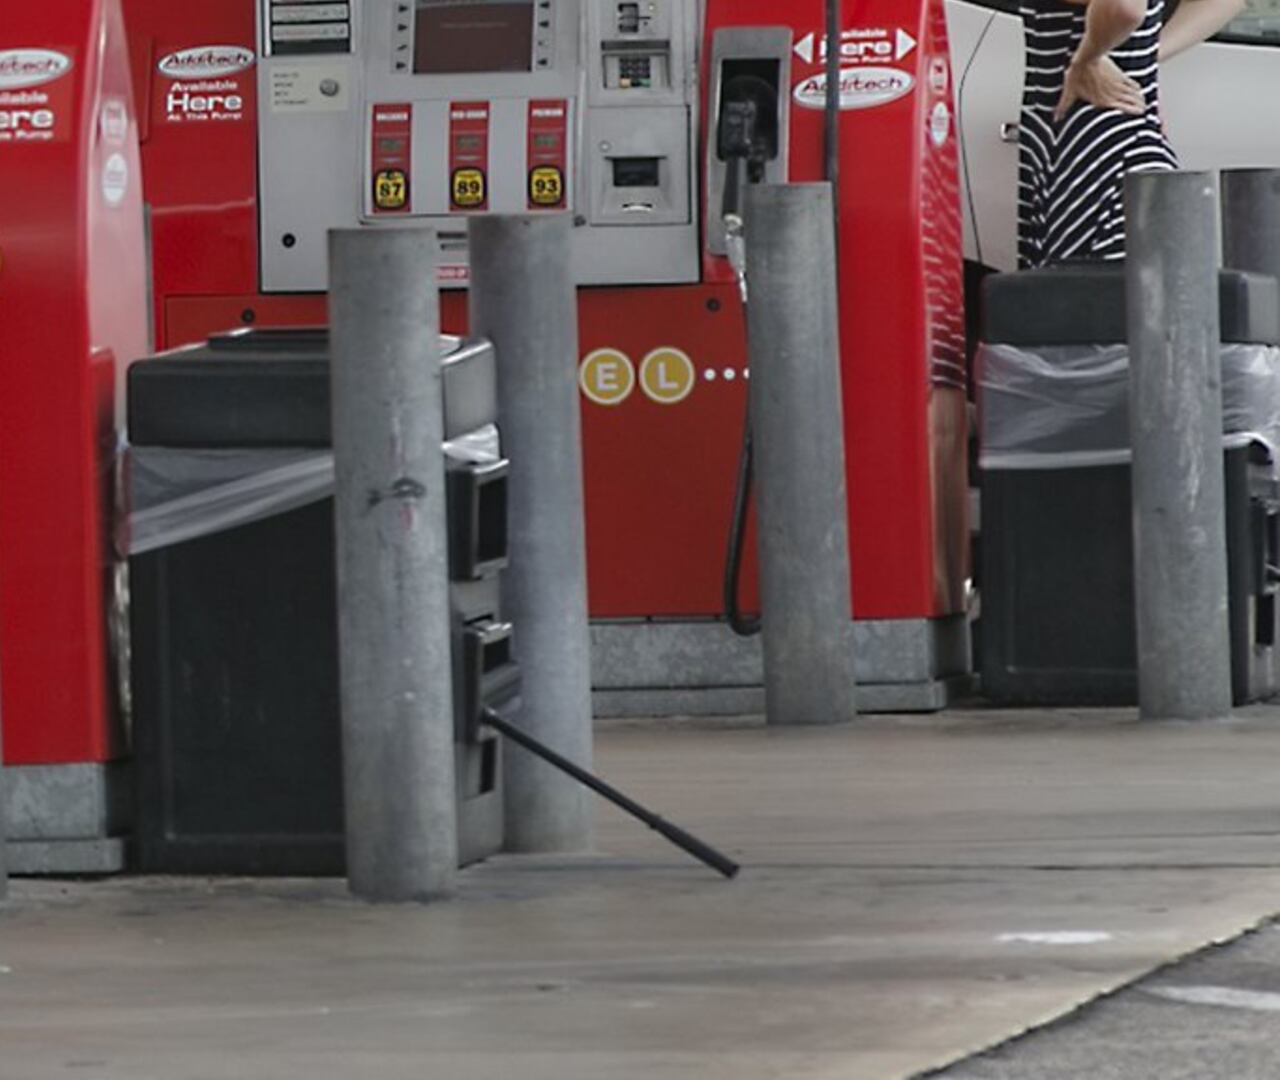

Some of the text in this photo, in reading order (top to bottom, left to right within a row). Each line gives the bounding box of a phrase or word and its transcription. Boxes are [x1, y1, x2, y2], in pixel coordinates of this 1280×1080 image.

[165, 51, 249, 69] Additech
[171, 79, 238, 93] Available
[166, 92, 243, 113] Here
[379, 183, 402, 198] 87
[456, 180, 480, 195] 89
[534, 179, 559, 193] 93
